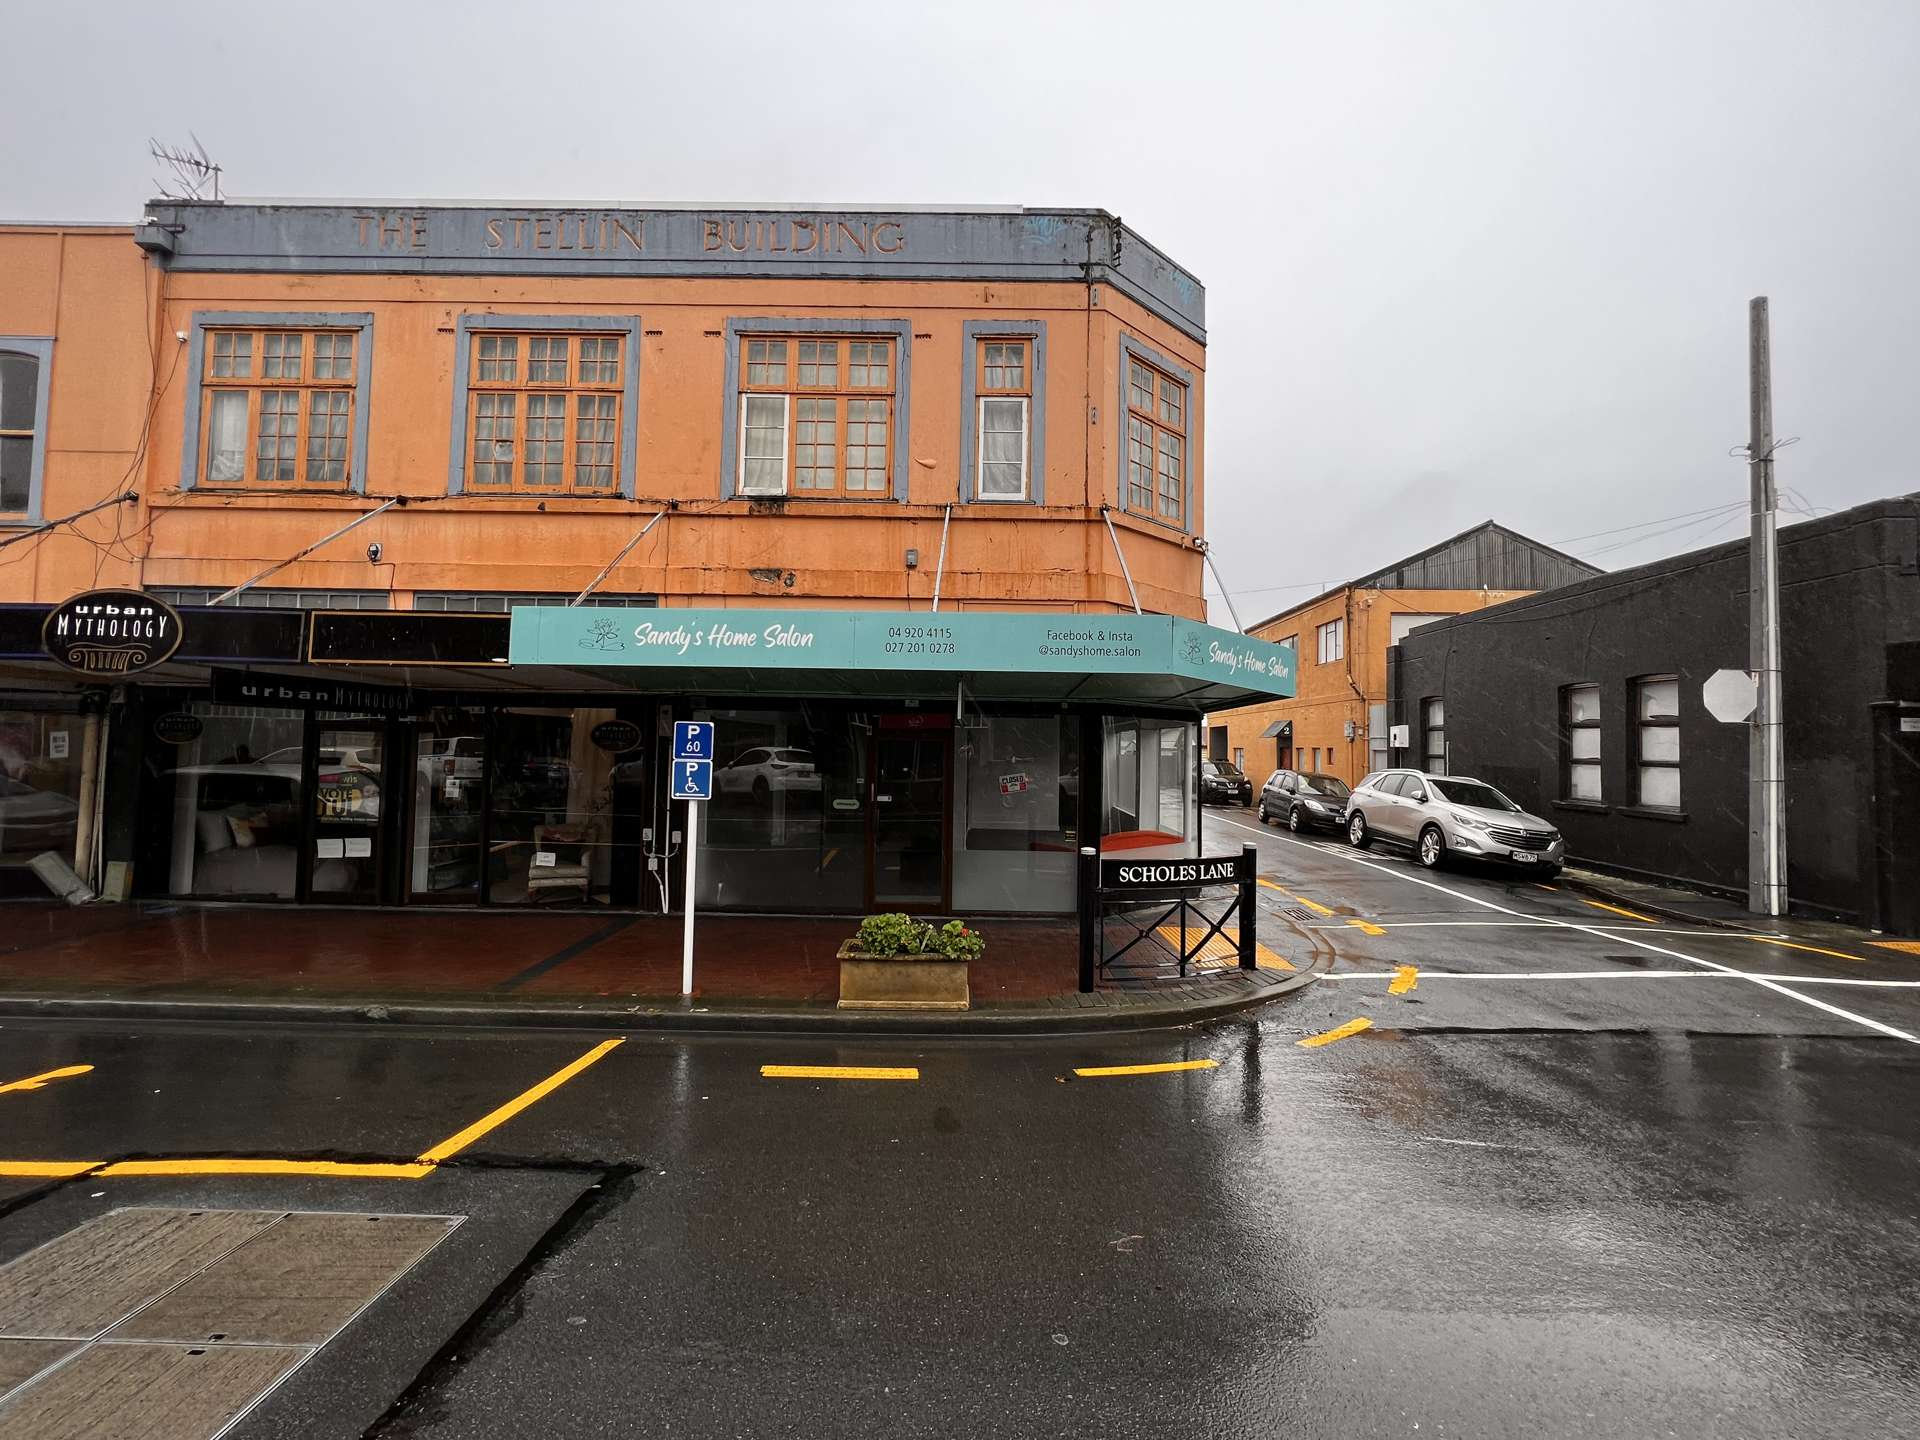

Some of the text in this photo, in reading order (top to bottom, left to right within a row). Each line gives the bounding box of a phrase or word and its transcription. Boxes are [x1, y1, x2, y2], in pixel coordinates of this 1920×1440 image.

[353, 215, 904, 254] THE STELLIN BUILDING
[75, 605, 153, 616] urban
[57, 614, 167, 638] MYTHOLOGY
[634, 622, 814, 655] Sandy's Home Salon
[888, 628, 952, 639] 04 920 4115
[1047, 630, 1133, 641] Facebook & Insta
[885, 643, 955, 654] 027 201 0278
[1039, 645, 1141, 658] @sandyshome.salon
[1208, 641, 1289, 679] Sandy's Home Salon
[241, 686, 329, 701] urban
[688, 725, 701, 739] P
[1284, 726, 1290, 735] 2
[686, 741, 701, 752] 60
[686, 762, 699, 777] P
[1119, 862, 1234, 882] SCHOLES LANE
